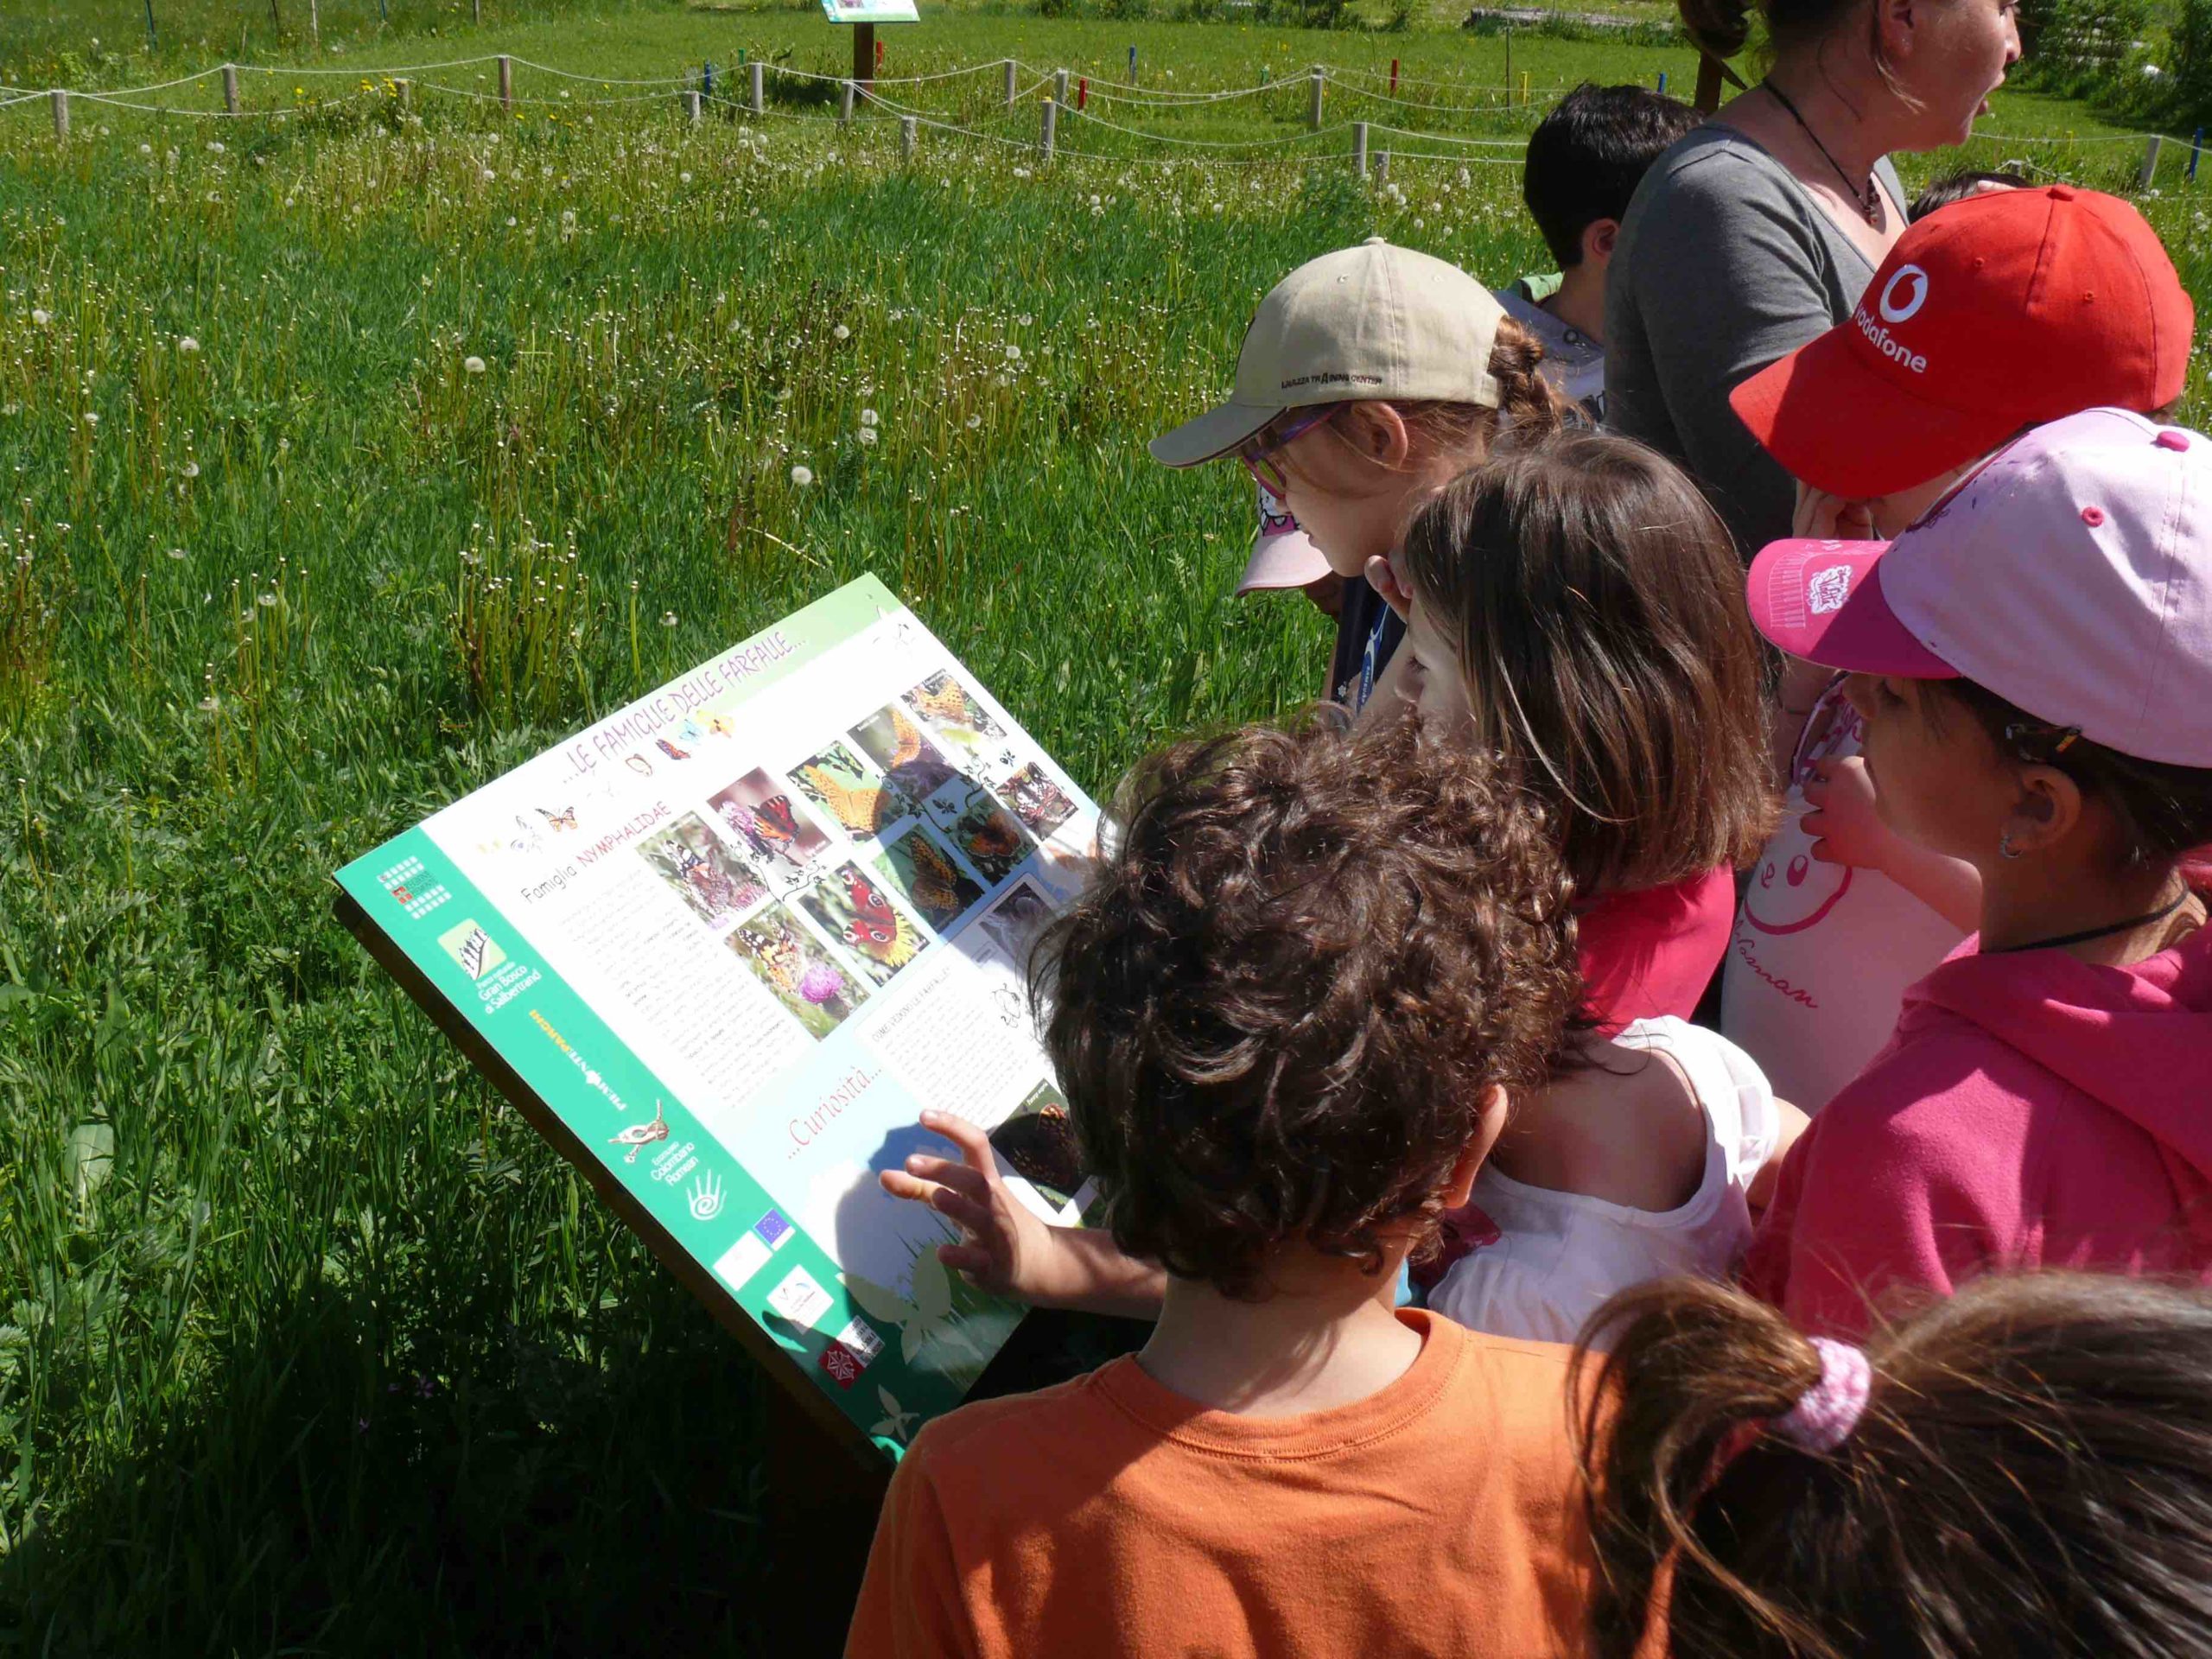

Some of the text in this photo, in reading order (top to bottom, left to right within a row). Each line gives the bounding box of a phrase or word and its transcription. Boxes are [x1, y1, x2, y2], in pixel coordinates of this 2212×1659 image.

[1855, 302, 1927, 373] vodafone
[593, 698, 677, 762] FAMIGLIE
[668, 671, 724, 715] DELLE
[520, 800, 672, 905] Famiglia NYMPHALIDAE
[478, 965, 528, 1001] Gran Bosco
[650, 1141, 696, 1181] Colombano
[664, 1156, 699, 1186] Romean
